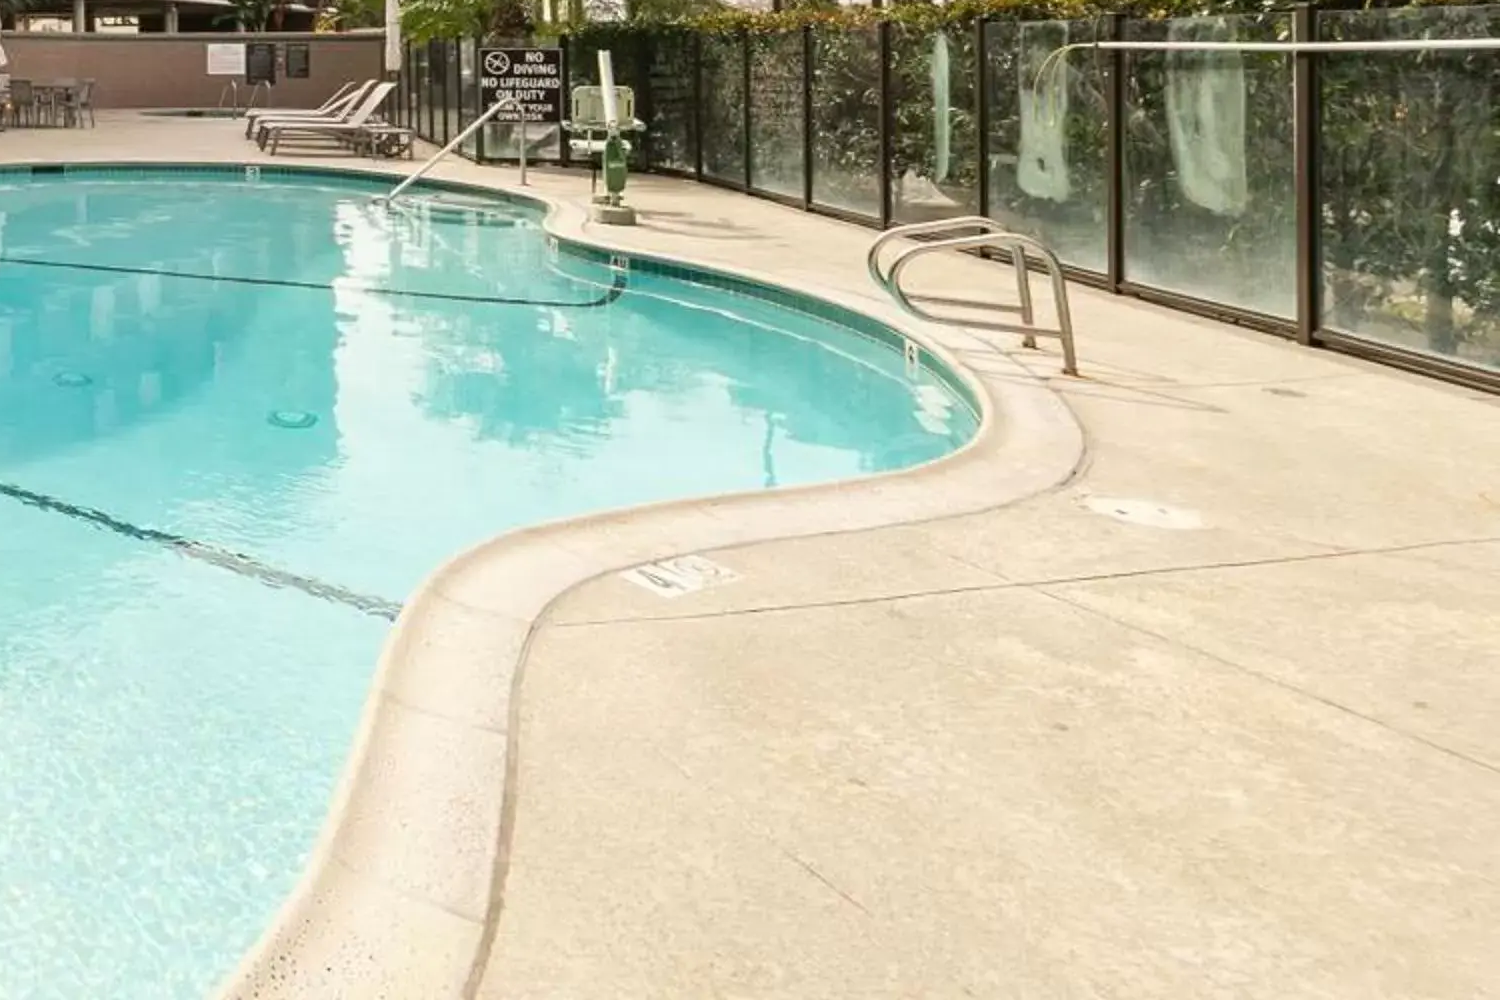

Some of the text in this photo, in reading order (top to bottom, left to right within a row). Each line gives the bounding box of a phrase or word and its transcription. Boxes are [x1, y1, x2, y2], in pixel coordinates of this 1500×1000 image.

[525, 51, 544, 63] NO
[513, 63, 557, 75] DIVING
[480, 77, 498, 89] NO
[500, 77, 560, 89] LIFEGUARD
[515, 89, 545, 101] DUTY
